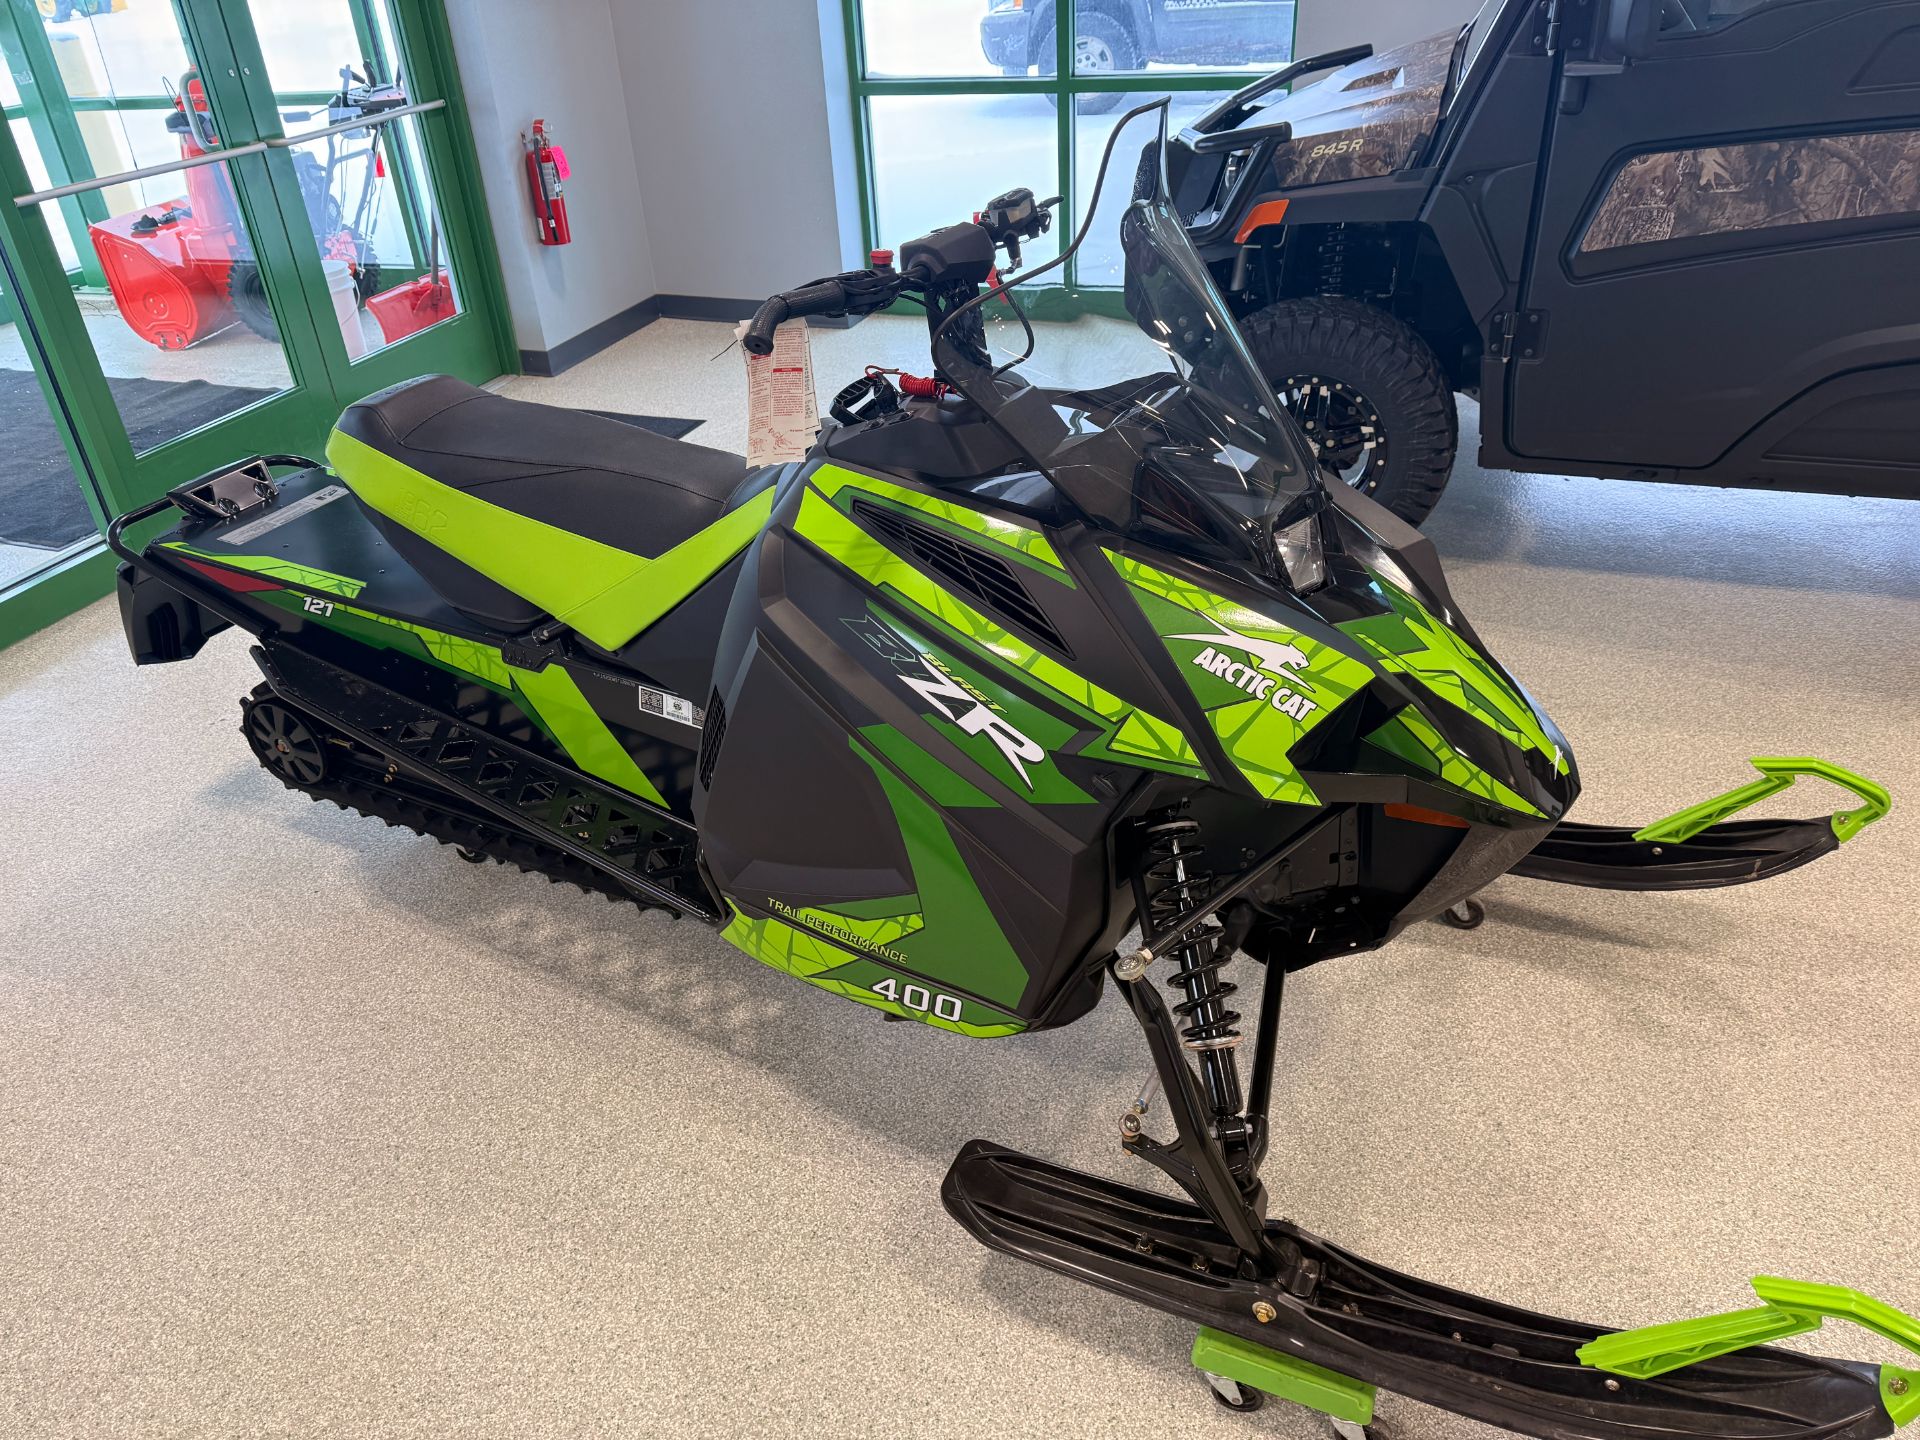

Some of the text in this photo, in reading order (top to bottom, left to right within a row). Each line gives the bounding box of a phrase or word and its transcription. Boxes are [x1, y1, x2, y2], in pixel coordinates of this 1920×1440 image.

[303, 596, 335, 617] 121
[1192, 646, 1318, 722] ARCTIC CAT
[896, 654, 1046, 793] ZR
[767, 897, 909, 965] TRAIL PERFORMANCE
[871, 977, 963, 1023] 400
